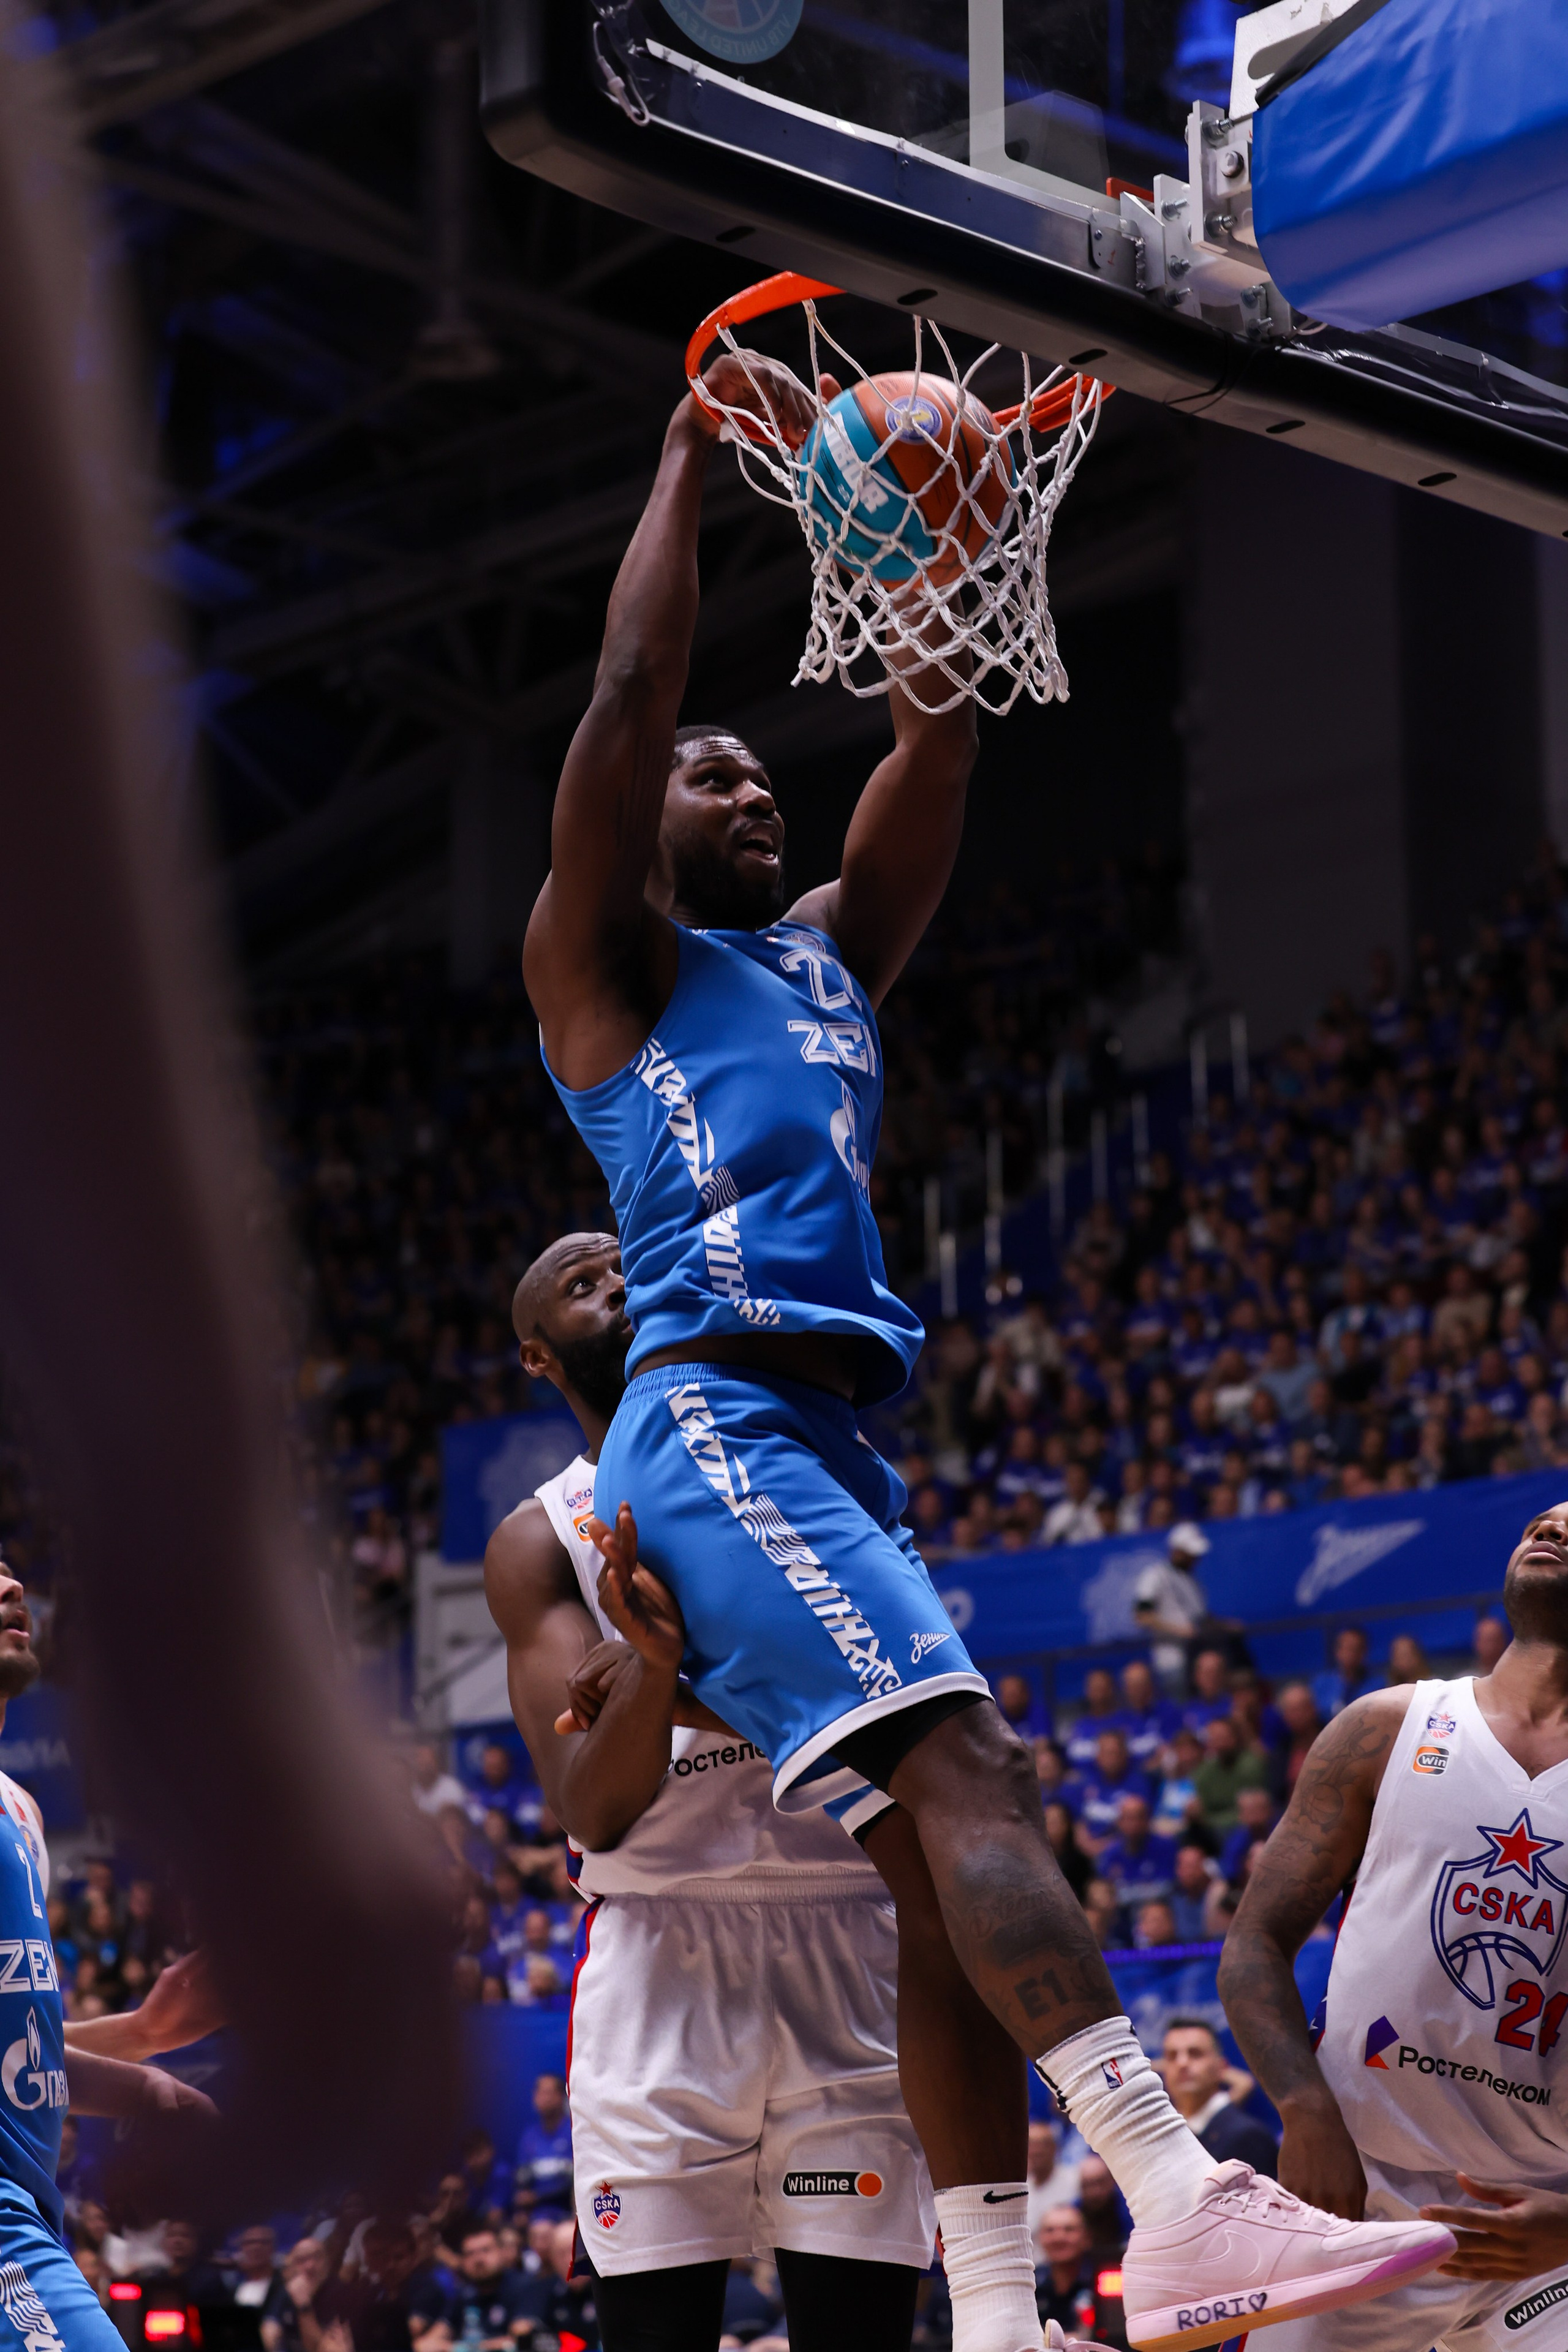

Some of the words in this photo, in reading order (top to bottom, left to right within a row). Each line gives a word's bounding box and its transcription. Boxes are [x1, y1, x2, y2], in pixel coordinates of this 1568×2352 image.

[1429, 1720, 1455, 1730] CSKA
[1422, 1755, 1446, 1767] Win
[1453, 1882, 1555, 1936] CSKA
[1494, 1978, 1568, 2058] 24
[1399, 2045, 1551, 2106] Ростелеком
[787, 2176, 850, 2192] Winline
[595, 2198, 620, 2211] CSKA
[1177, 2297, 1246, 2331] RORI
